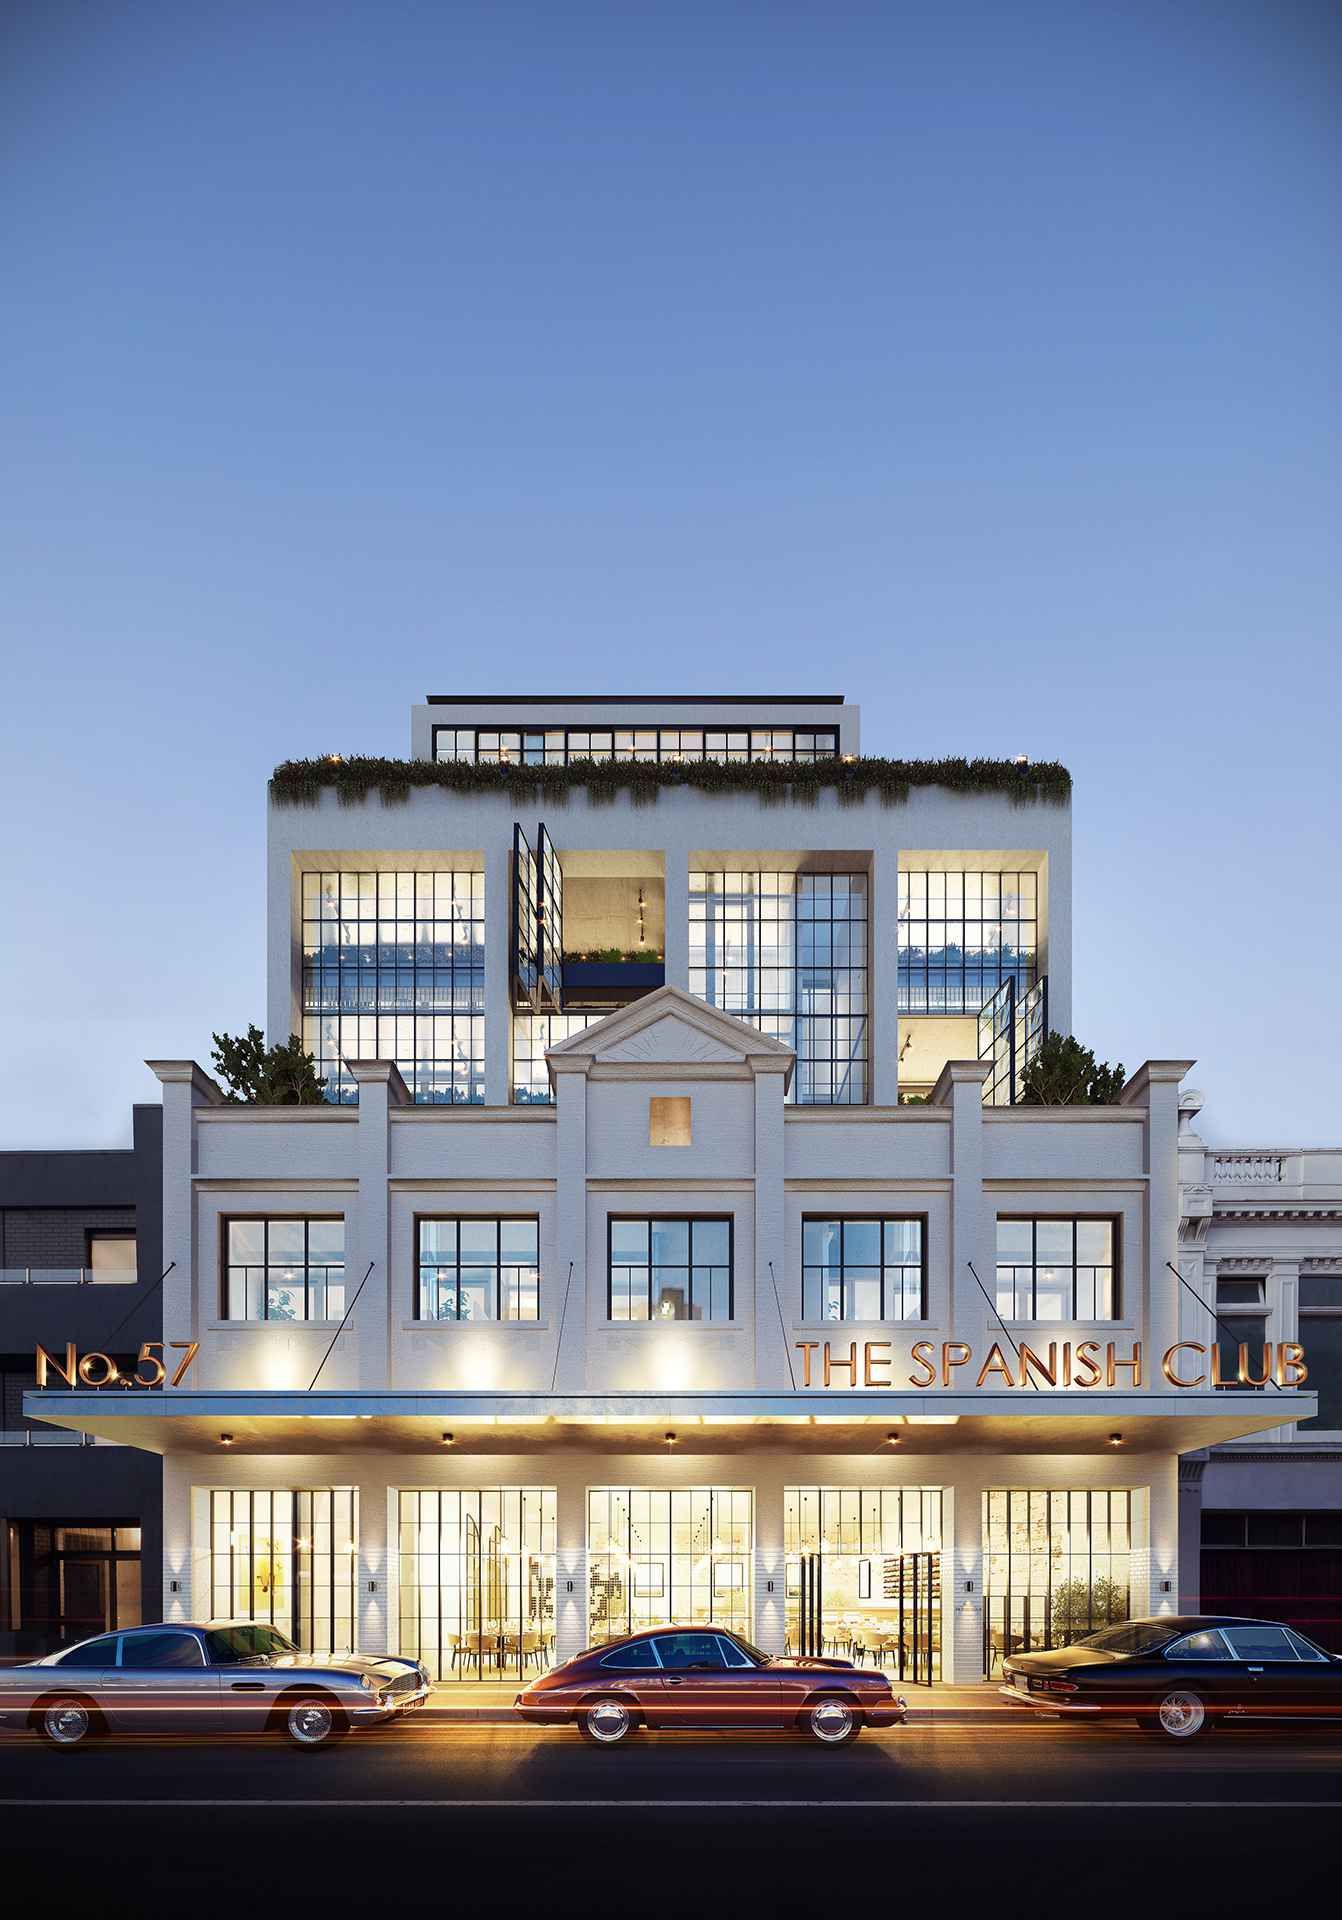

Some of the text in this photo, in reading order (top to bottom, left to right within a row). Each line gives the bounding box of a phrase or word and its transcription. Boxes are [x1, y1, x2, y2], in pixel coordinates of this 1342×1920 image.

[36, 1342, 200, 1387] No.57
[795, 1341, 1309, 1387] THE SPANISH CLUB
